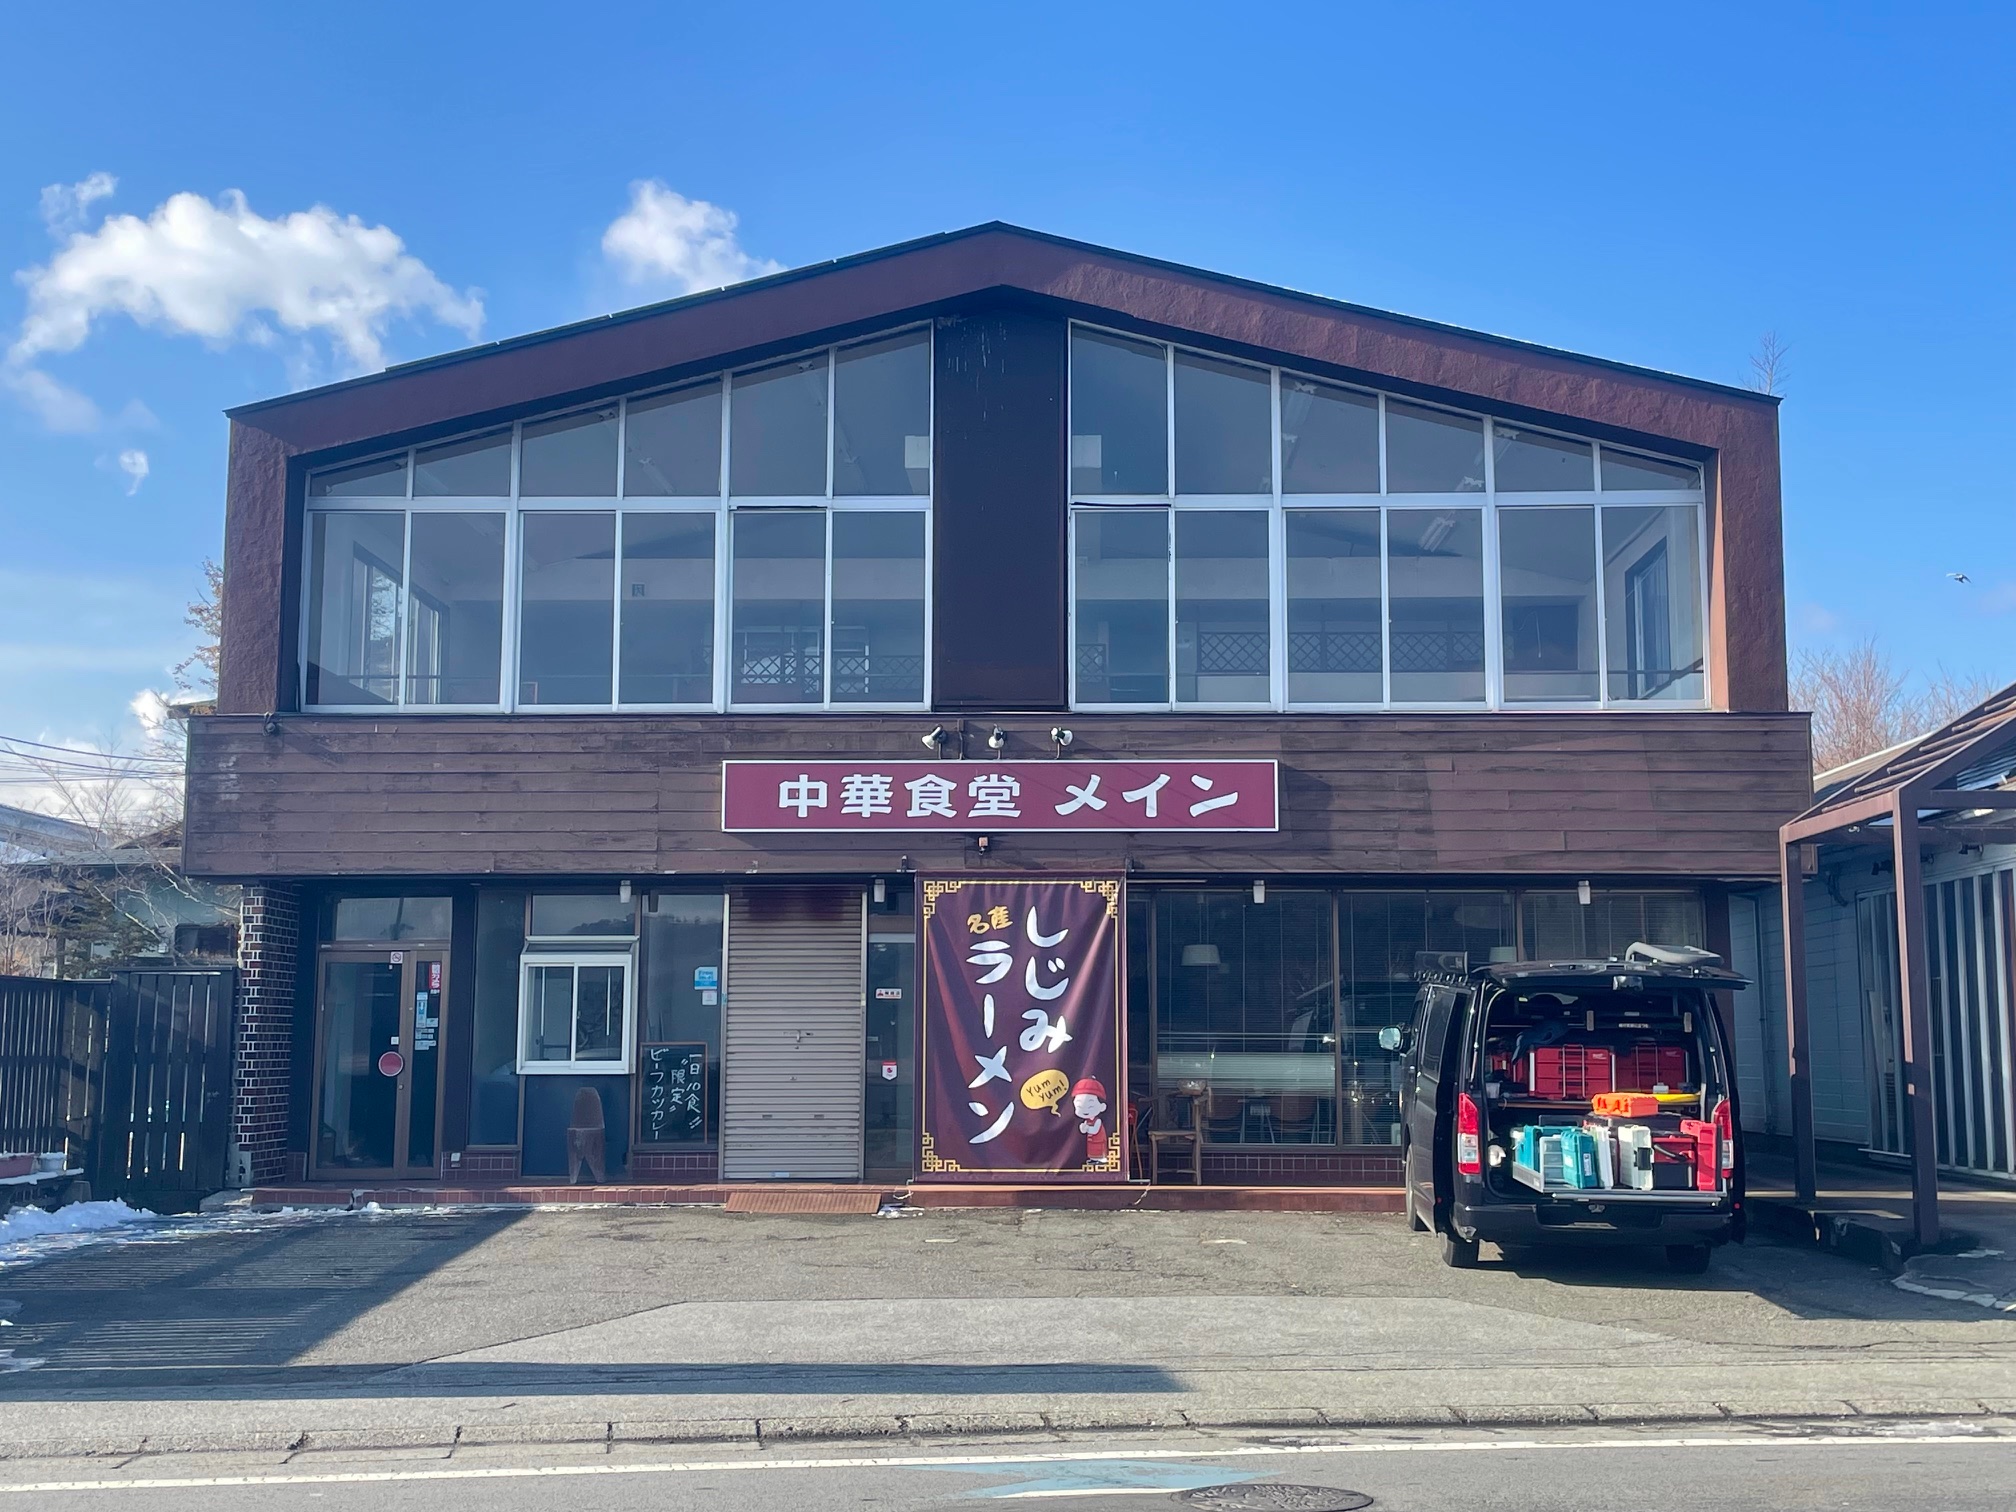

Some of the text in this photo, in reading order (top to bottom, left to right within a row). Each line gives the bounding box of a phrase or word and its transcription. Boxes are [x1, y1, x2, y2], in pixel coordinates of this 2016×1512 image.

[778, 773, 1240, 819] 中華食堂 メイン
[966, 905, 1014, 935] 名産
[1018, 904, 1074, 1054] しじみ
[965, 939, 1015, 1145] ラーメン
[649, 1048, 669, 1140] ビーフカツカレー
